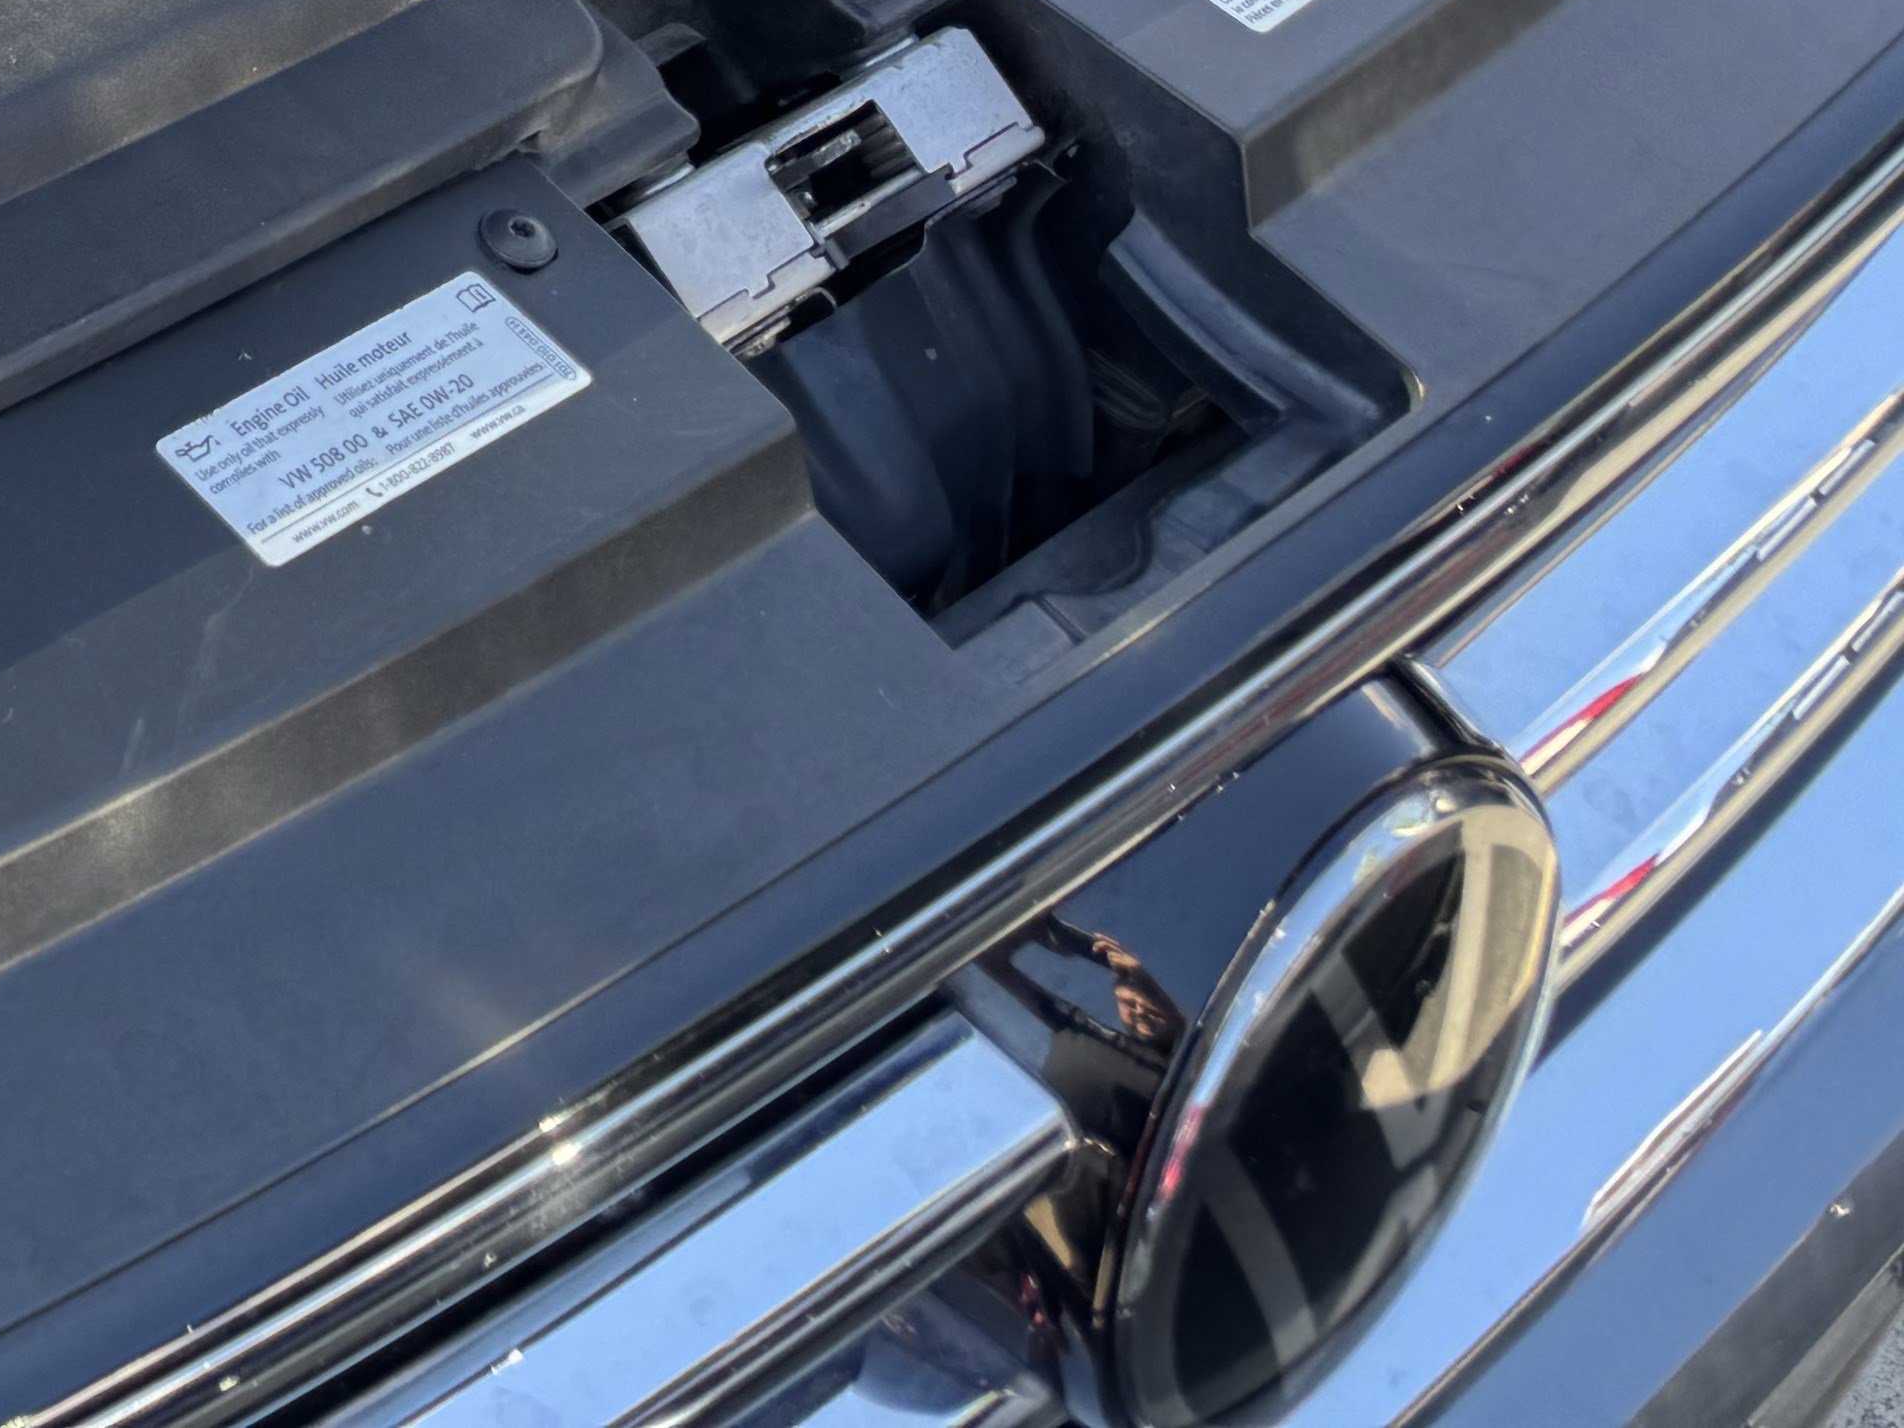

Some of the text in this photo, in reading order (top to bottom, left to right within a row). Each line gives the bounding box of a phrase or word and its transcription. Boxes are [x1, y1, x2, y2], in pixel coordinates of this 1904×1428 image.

[227, 327, 415, 441] Engine Oil Huile moteur
[331, 376, 376, 406] Utilisez
[369, 343, 438, 387] uniquement
[429, 335, 451, 351] de
[345, 400, 372, 421] qui
[362, 378, 410, 409] satisfait
[470, 335, 485, 348] à
[193, 402, 329, 482] Use only oil that expressly
[277, 371, 477, 492] VW 508 00 & SAE 0W-20
[383, 432, 416, 456] Pour
[408, 423, 435, 442] une
[426, 410, 455, 431] liste
[205, 447, 283, 498] complies with
[289, 403, 528, 544] www.vw.com 1-800-822-8987 www.vw.ca
[302, 466, 359, 504] approved
[244, 515, 271, 536] For
[263, 513, 280, 526] a
[271, 500, 297, 521] list
[288, 493, 309, 511] of
